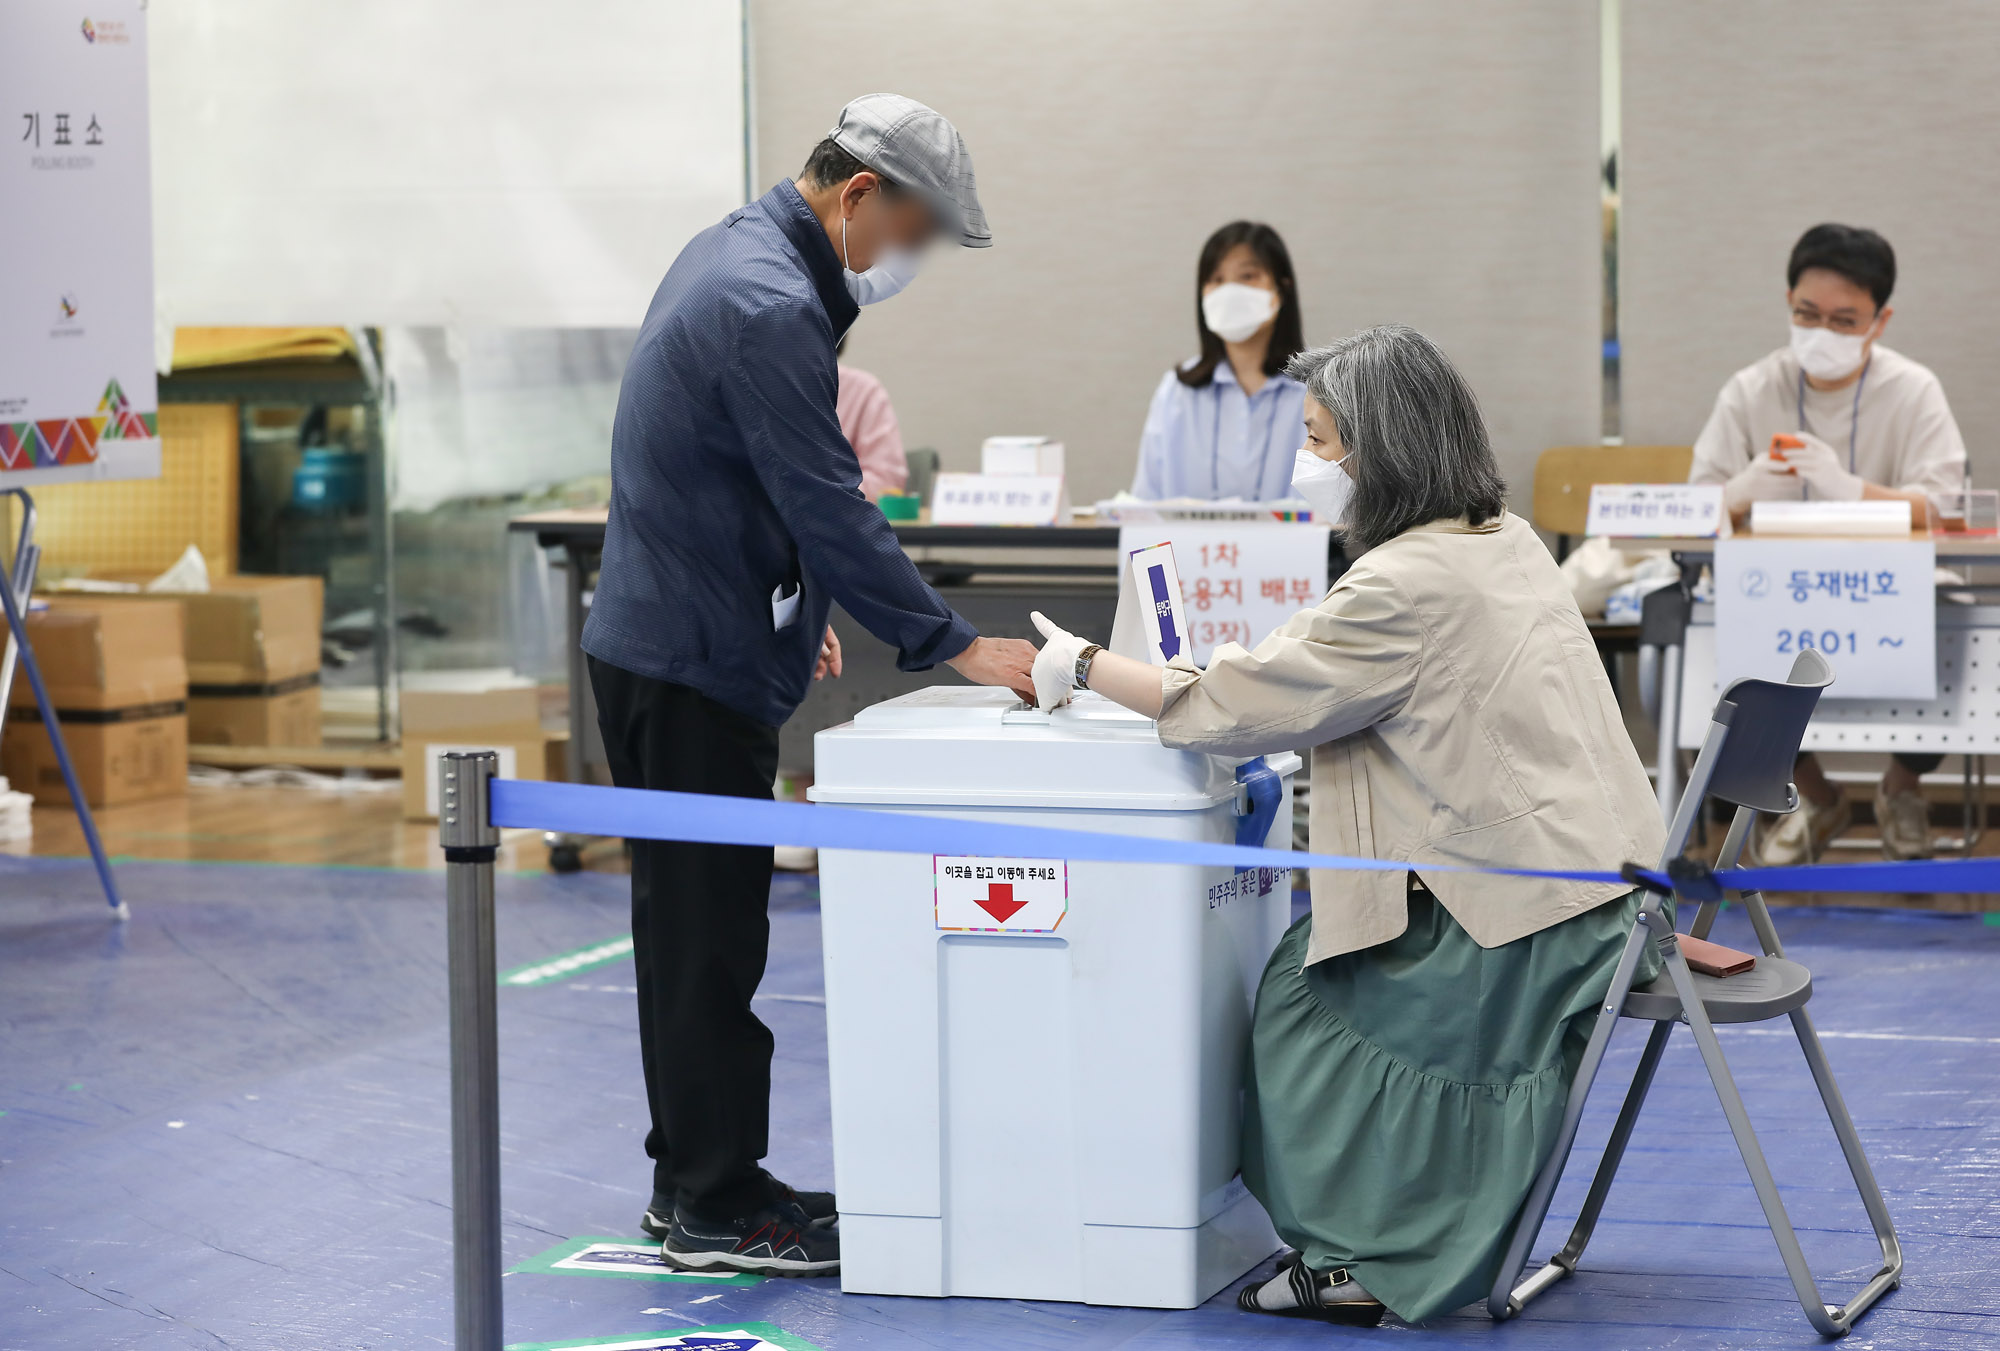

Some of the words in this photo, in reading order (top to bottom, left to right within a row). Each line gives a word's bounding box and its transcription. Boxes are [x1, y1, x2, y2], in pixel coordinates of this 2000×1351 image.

[1199, 541, 1240, 569] 1차
[1259, 577, 1315, 606] 배부
[1785, 570, 1899, 603] 등재번호
[1156, 599, 1173, 618] 투입구
[1775, 629, 1856, 655] 2601
[945, 865, 973, 879] 이곳을
[976, 866, 994, 879] 잡고
[997, 867, 1025, 880] 이동해
[1028, 867, 1056, 881] 주세요
[1208, 877, 1238, 910] 민주주의
[1241, 870, 1256, 897] 꽃은
